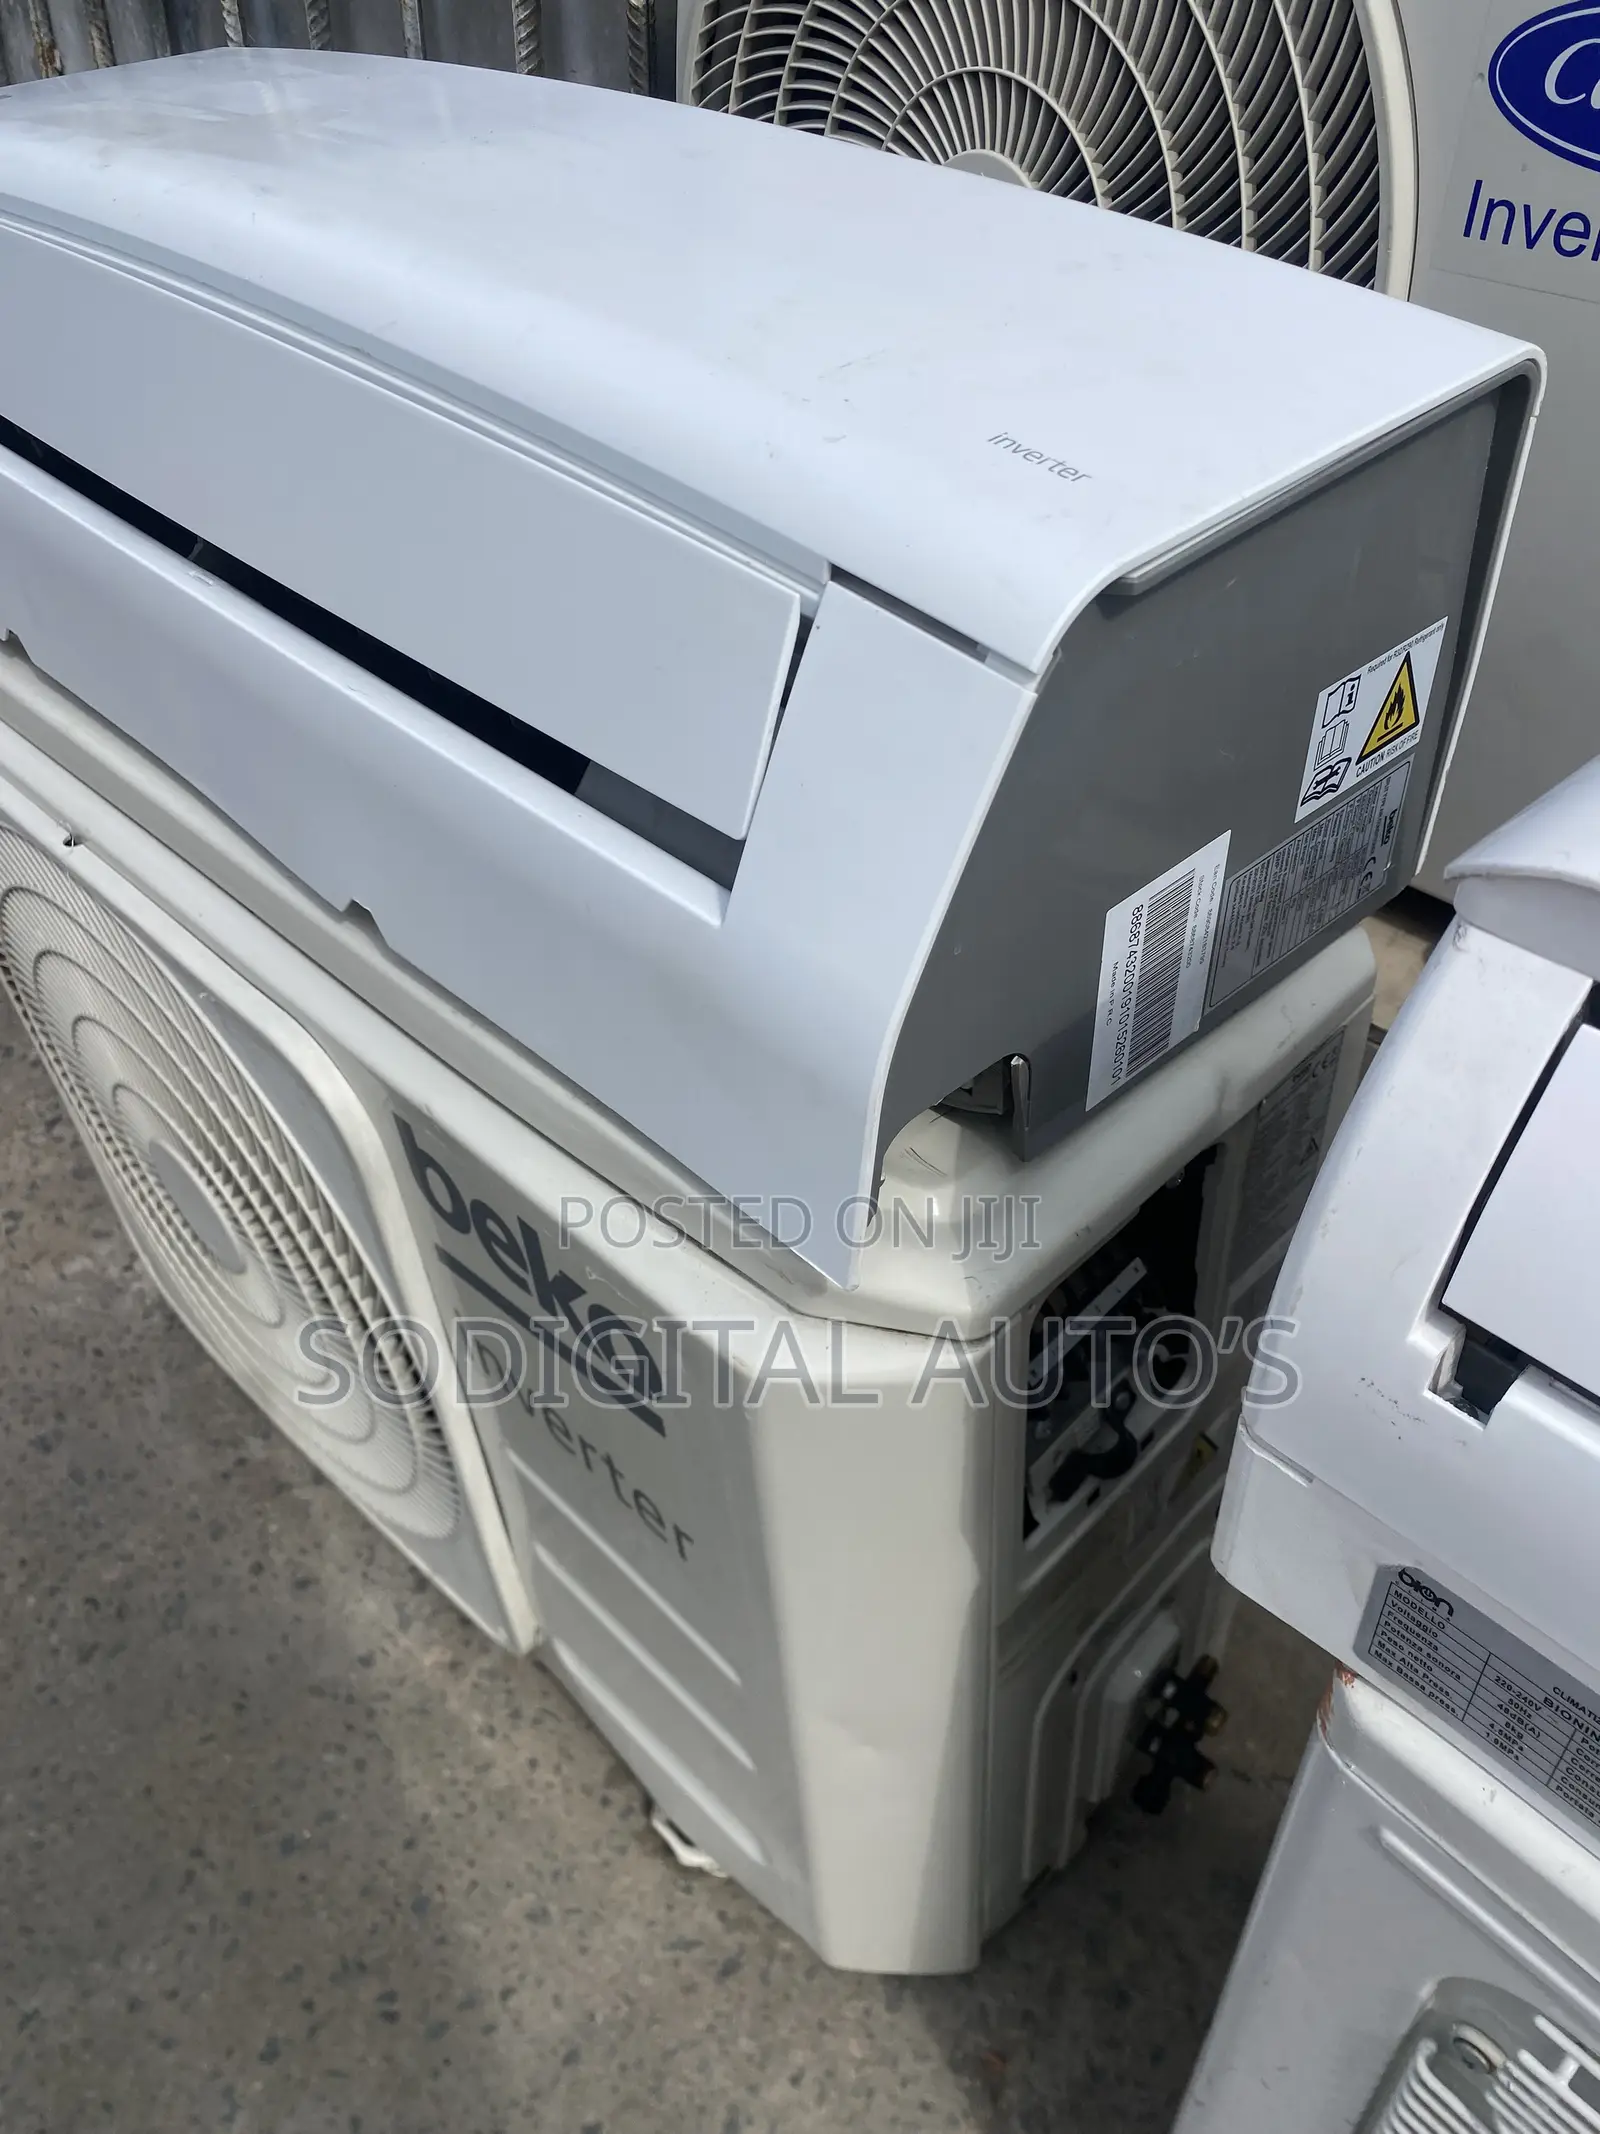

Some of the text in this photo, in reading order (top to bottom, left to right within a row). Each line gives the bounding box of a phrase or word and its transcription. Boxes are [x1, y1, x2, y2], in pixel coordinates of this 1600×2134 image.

[1544, 37, 1600, 110] C
[987, 432, 1092, 482] inverter
[1356, 730, 1418, 777] CAUTION RISK OF FIRE
[1383, 808, 1397, 845] beko
[1197, 875, 1205, 897] Stock
[1110, 961, 1119, 988] Made
[1110, 904, 1144, 1086] 8868743200191015260101
[393, 1111, 662, 1398] beko
[1391, 1599, 1439, 1638] Voltaggio
[1394, 1590, 1445, 1630] MODELLO
[1388, 1610, 1439, 1651] Frequenza
[1378, 1640, 1453, 1699] Max Alta Press.
[1380, 1630, 1433, 1672] Peso netto
[1384, 1621, 1461, 1681] Potenza sonora
[1375, 1650, 1459, 1716] Max Bassa press.
[1494, 1676, 1542, 1712] 220-240V
[1497, 1703, 1540, 1738] 48dB(A)
[1508, 1698, 1532, 1719] 50Hz
[1543, 1697, 1600, 1742] BIONIN
[1489, 1722, 1524, 1752] 4.5MPa
[1505, 1721, 1523, 1739] 8kg
[1556, 1785, 1594, 1818] Portata
